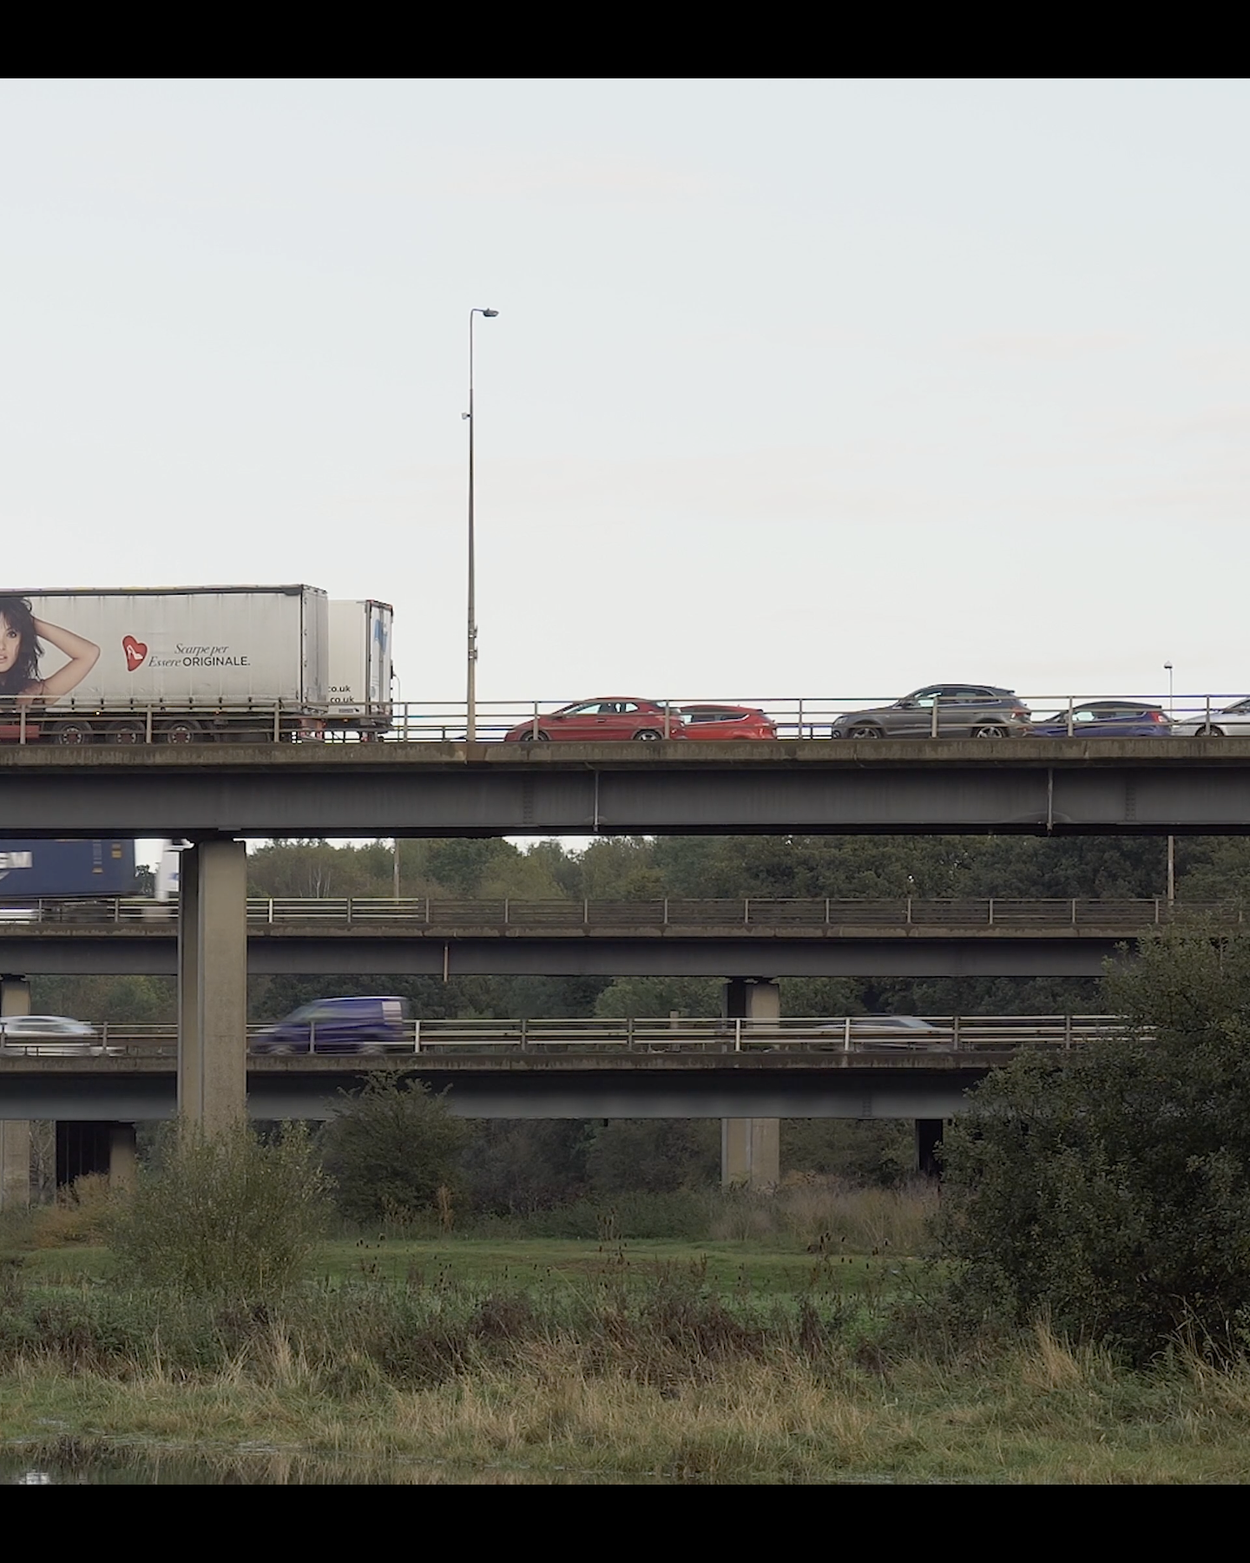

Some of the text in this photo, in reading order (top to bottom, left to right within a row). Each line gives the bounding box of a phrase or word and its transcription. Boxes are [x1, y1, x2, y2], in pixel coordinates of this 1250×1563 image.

[174, 643, 229, 656] Scarpe per
[148, 656, 250, 667] Essere ORIGINALE.
